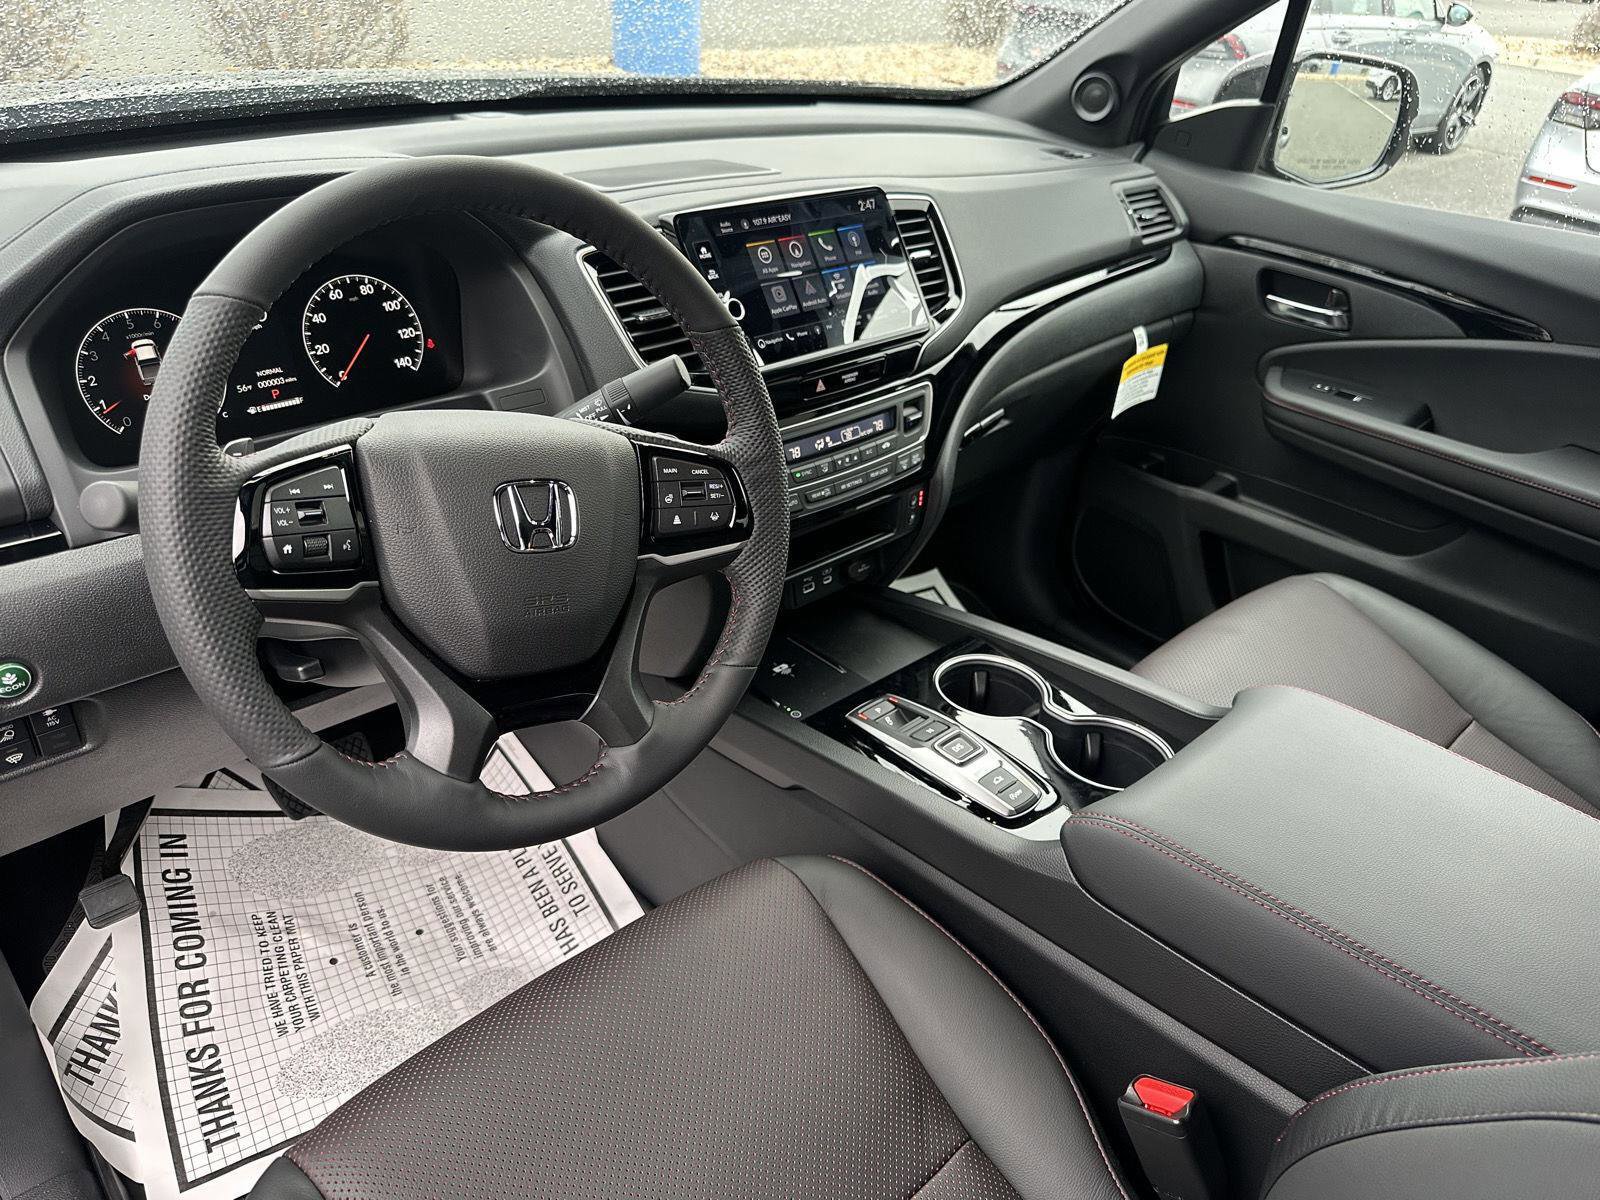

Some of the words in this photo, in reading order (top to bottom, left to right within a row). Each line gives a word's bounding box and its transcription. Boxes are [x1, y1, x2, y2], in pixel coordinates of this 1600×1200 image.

[858, 199, 875, 212] 2:47
[329, 289, 343, 300] 60
[360, 284, 374, 295] 80
[382, 300, 401, 312] 100
[771, 307, 782, 315] Apple
[782, 304, 798, 312] CarPlay
[126, 318, 135, 330] 5
[153, 318, 161, 329] 6
[312, 312, 327, 323] 40
[102, 331, 110, 341] 4
[398, 327, 416, 339] 120
[315, 343, 330, 355] 20
[89, 351, 99, 362] 3
[394, 356, 412, 368] 140
[256, 367, 283, 377] NORMAL
[87, 375, 98, 386] 2
[257, 377, 285, 389] 000003
[271, 389, 280, 399] P
[99, 399, 107, 410] 1
[122, 416, 132, 426] 0
[873, 420, 884, 431] 78
[789, 446, 801, 459] 78
[0, 681, 26, 694] ECON
[46, 719, 60, 728] 115V
[159, 834, 189, 858] IN
[509, 847, 533, 869] PL
[522, 866, 540, 880] A
[542, 844, 578, 895] SERVE
[426, 884, 437, 896] for
[439, 876, 458, 904] service
[527, 879, 560, 919] BEEN
[568, 893, 590, 918] TO
[354, 892, 373, 922] person
[453, 905, 465, 918] our
[161, 868, 207, 971] COMING
[251, 914, 267, 938] KEEP
[283, 915, 297, 935] MAT
[381, 920, 391, 930] to
[432, 896, 459, 943] suggestions
[472, 908, 491, 938] always
[266, 911, 283, 943] CLEAN
[348, 923, 358, 932] is
[364, 923, 388, 962] important
[383, 930, 401, 953] world
[460, 917, 484, 960] improving
[549, 917, 580, 956] HAS
[259, 941, 270, 954] TO
[485, 938, 498, 952] are
[288, 937, 306, 971] PAPER
[352, 934, 374, 971] customer
[453, 943, 467, 962] Your
[395, 953, 407, 967] the
[262, 957, 276, 991] TRIED
[275, 945, 298, 1002] CARPETING
[365, 970, 377, 978] A
[380, 962, 397, 982] most
[400, 966, 411, 976] in
[297, 972, 312, 995] THIS
[390, 983, 402, 997] the
[178, 978, 216, 1038] FOR
[267, 992, 285, 1019] HAVE
[304, 994, 320, 1021] WITH
[288, 1003, 306, 1033] YOUR
[64, 981, 121, 1086] THANK
[275, 1019, 289, 1037] WE
[186, 1044, 241, 1154] THANKS
